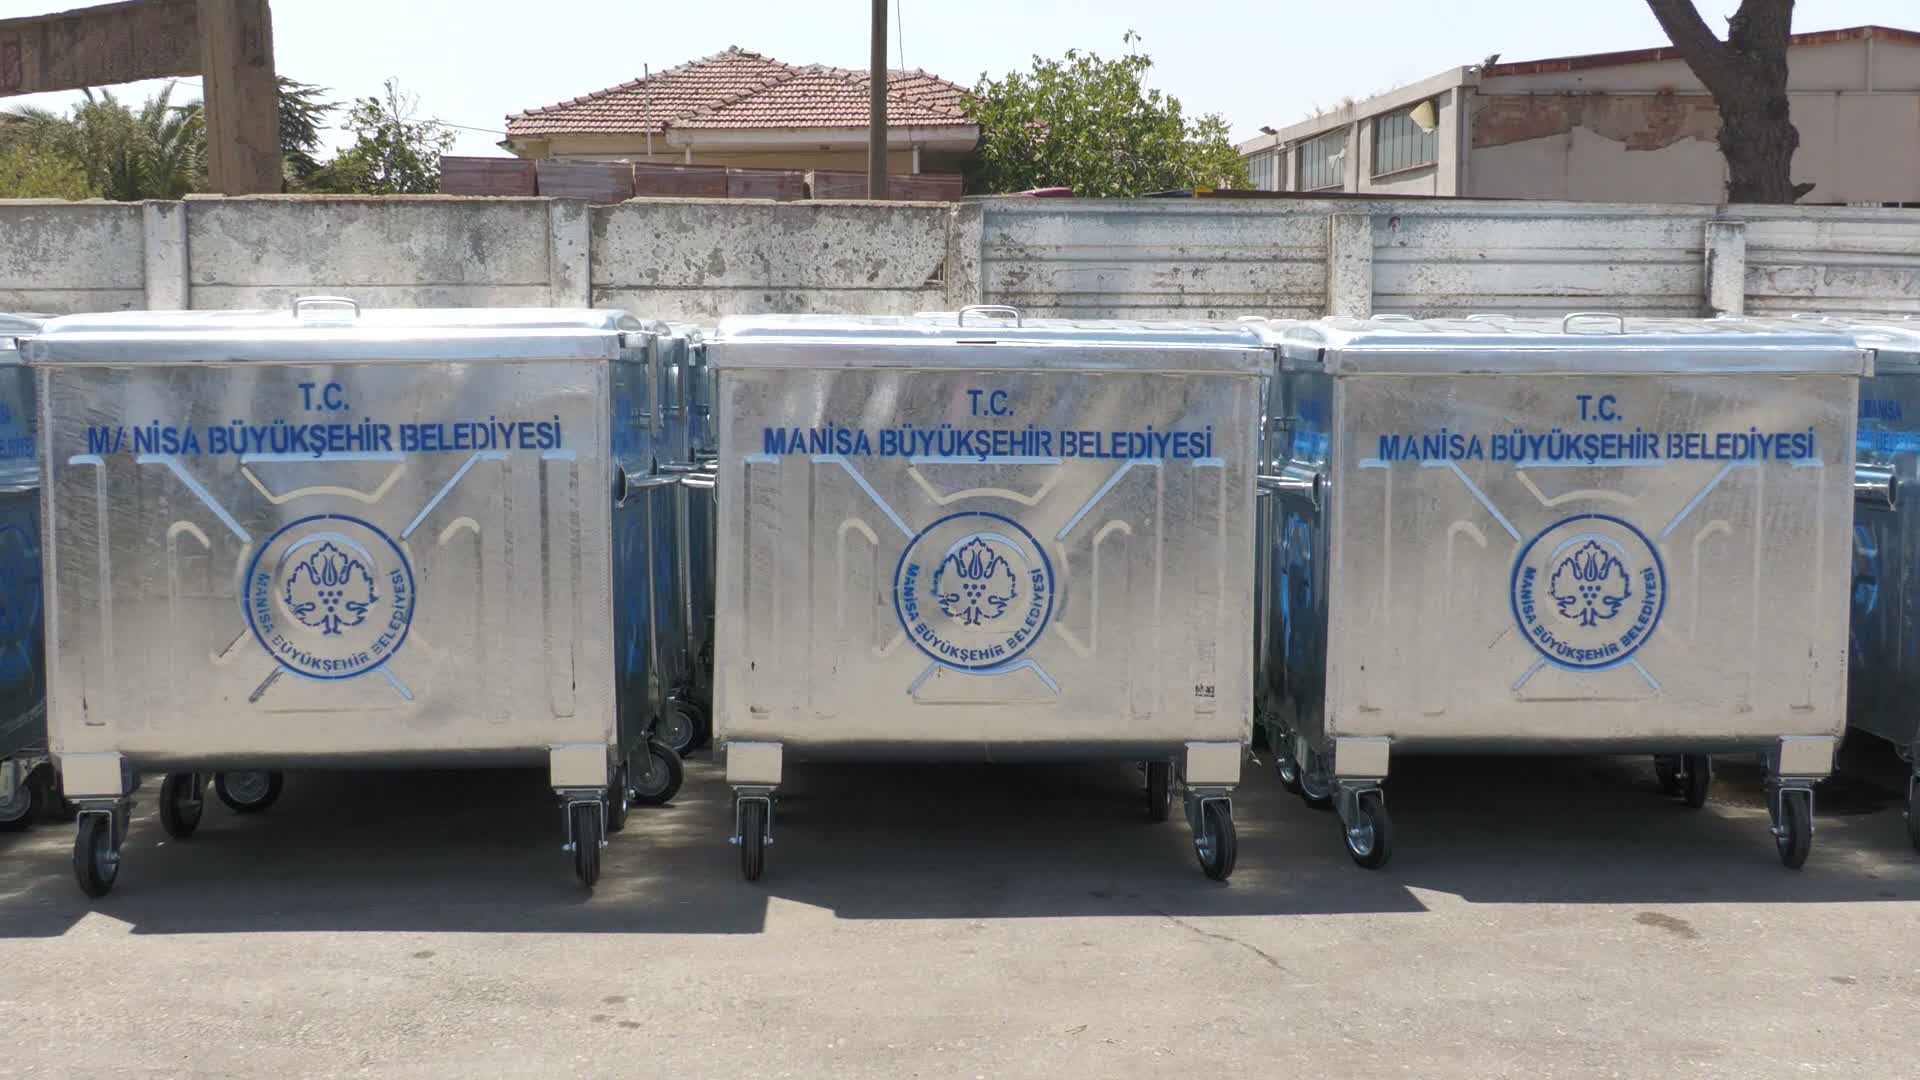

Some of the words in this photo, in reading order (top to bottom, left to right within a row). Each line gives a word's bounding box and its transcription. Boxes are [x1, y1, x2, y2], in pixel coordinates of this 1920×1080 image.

[298, 383, 349, 411] T.C.
[967, 389, 1014, 416] T.C.
[1576, 395, 1623, 421] T.C.
[208, 416, 393, 458] BÜYÜKŞEHİR
[400, 414, 562, 452] BELEDİYESİ
[763, 421, 872, 456] MANİSA
[879, 423, 1053, 462] BÜYÜKŞEHİR
[1060, 425, 1212, 459] BELEDİYESİ
[1379, 427, 1484, 461] MANİSA
[1491, 427, 1660, 464] BÜYÜKŞEHİR
[1667, 426, 1815, 460] BELEDİYESİ
[1520, 566, 1537, 625] MANİSA
[1532, 624, 1620, 662] BÜYÜKŞEHİR
